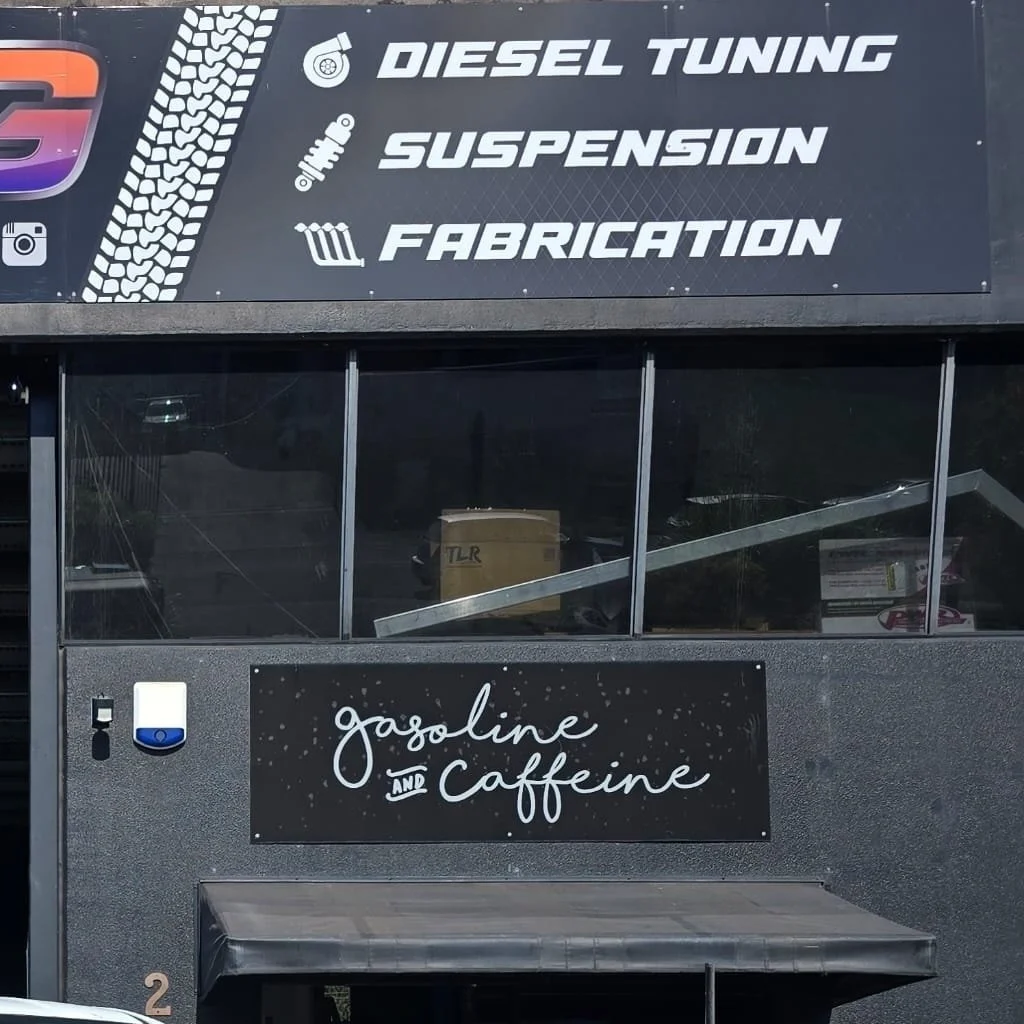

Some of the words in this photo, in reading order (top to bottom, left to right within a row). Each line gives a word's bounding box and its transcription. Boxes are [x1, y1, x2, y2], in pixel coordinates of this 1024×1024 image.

[377, 40, 624, 79] DIESEL
[646, 35, 898, 76] TUNING
[378, 126, 829, 170] SUSPENSION
[378, 218, 843, 262] FABRICATION
[333, 682, 599, 789] gasoline
[390, 772, 426, 797] AND
[144, 972, 172, 1016] 2
